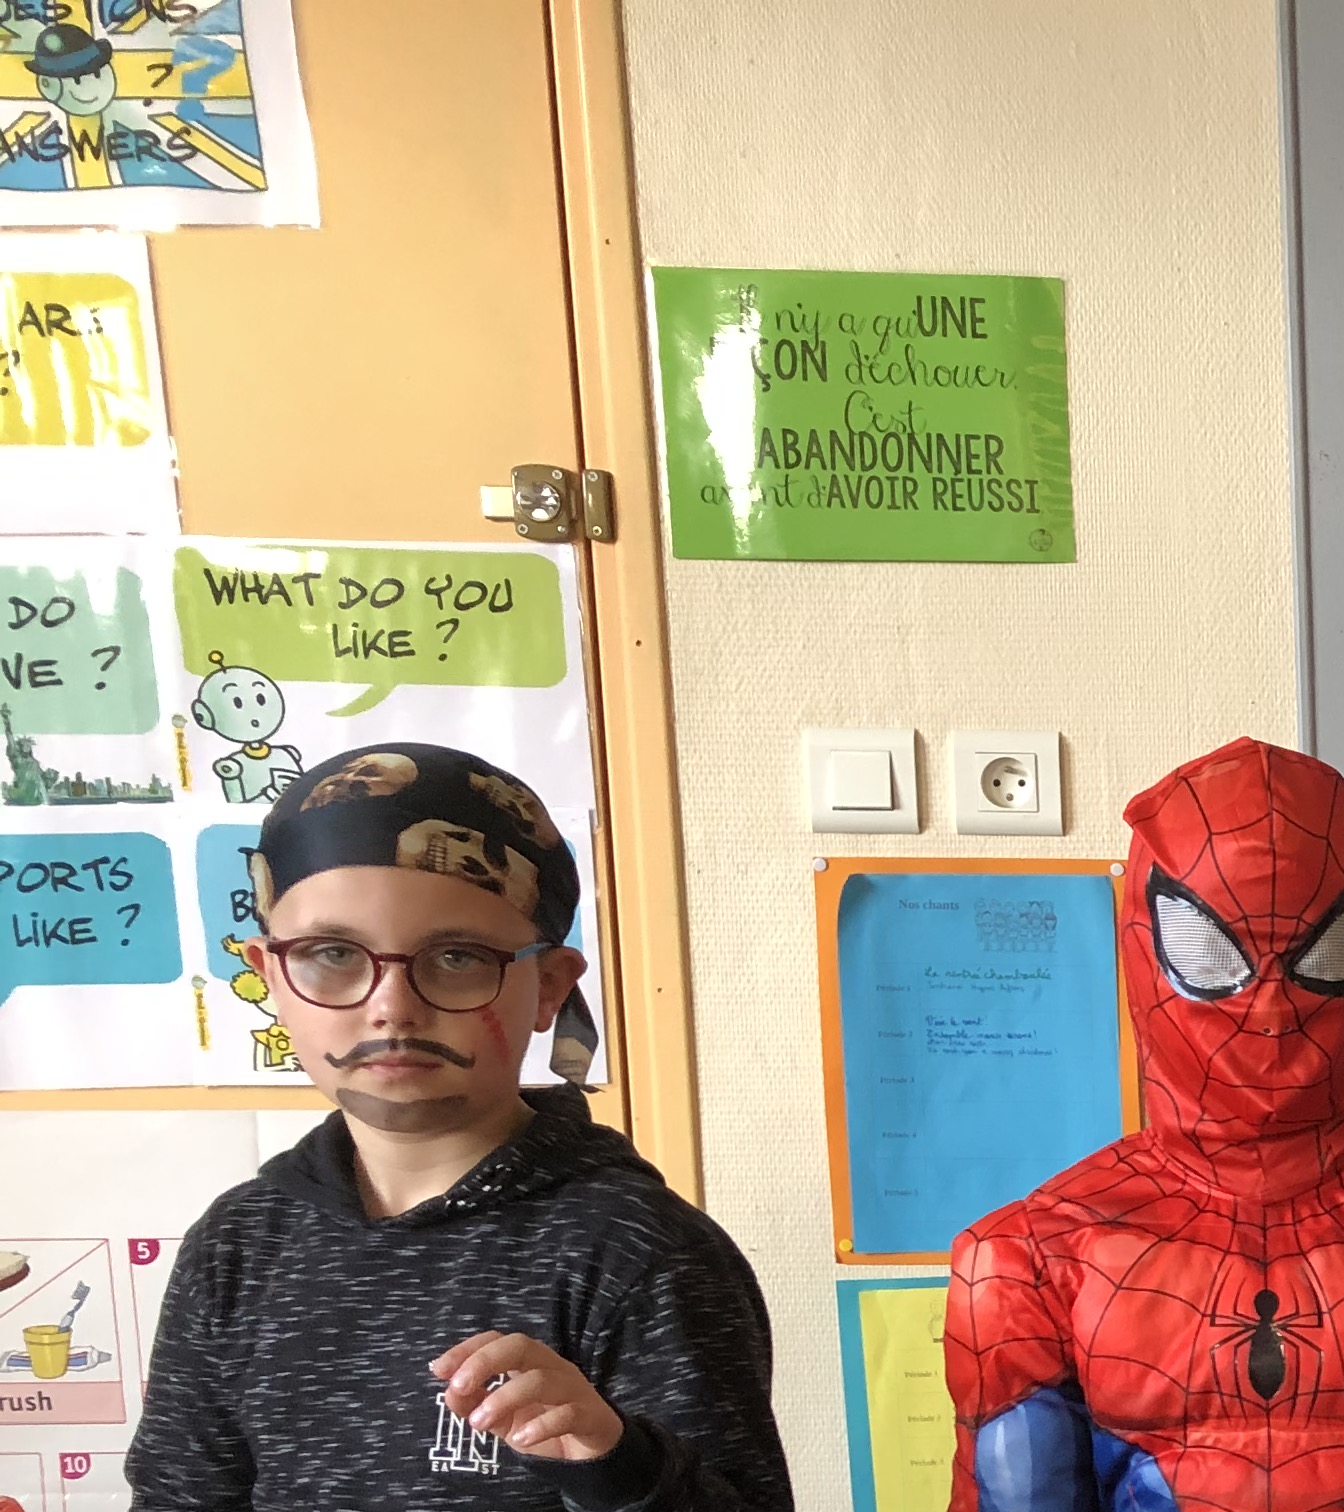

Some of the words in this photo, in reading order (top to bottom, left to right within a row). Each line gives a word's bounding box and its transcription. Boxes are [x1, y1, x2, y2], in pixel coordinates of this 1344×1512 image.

[757, 427, 1006, 476] ABANDONNER
[204, 568, 321, 607] WHAT
[338, 578, 404, 611] DO
[424, 576, 514, 613] YOU
[8, 597, 75, 629] DO
[136, 1241, 152, 1261] 5
[62, 1457, 88, 1474] 10
